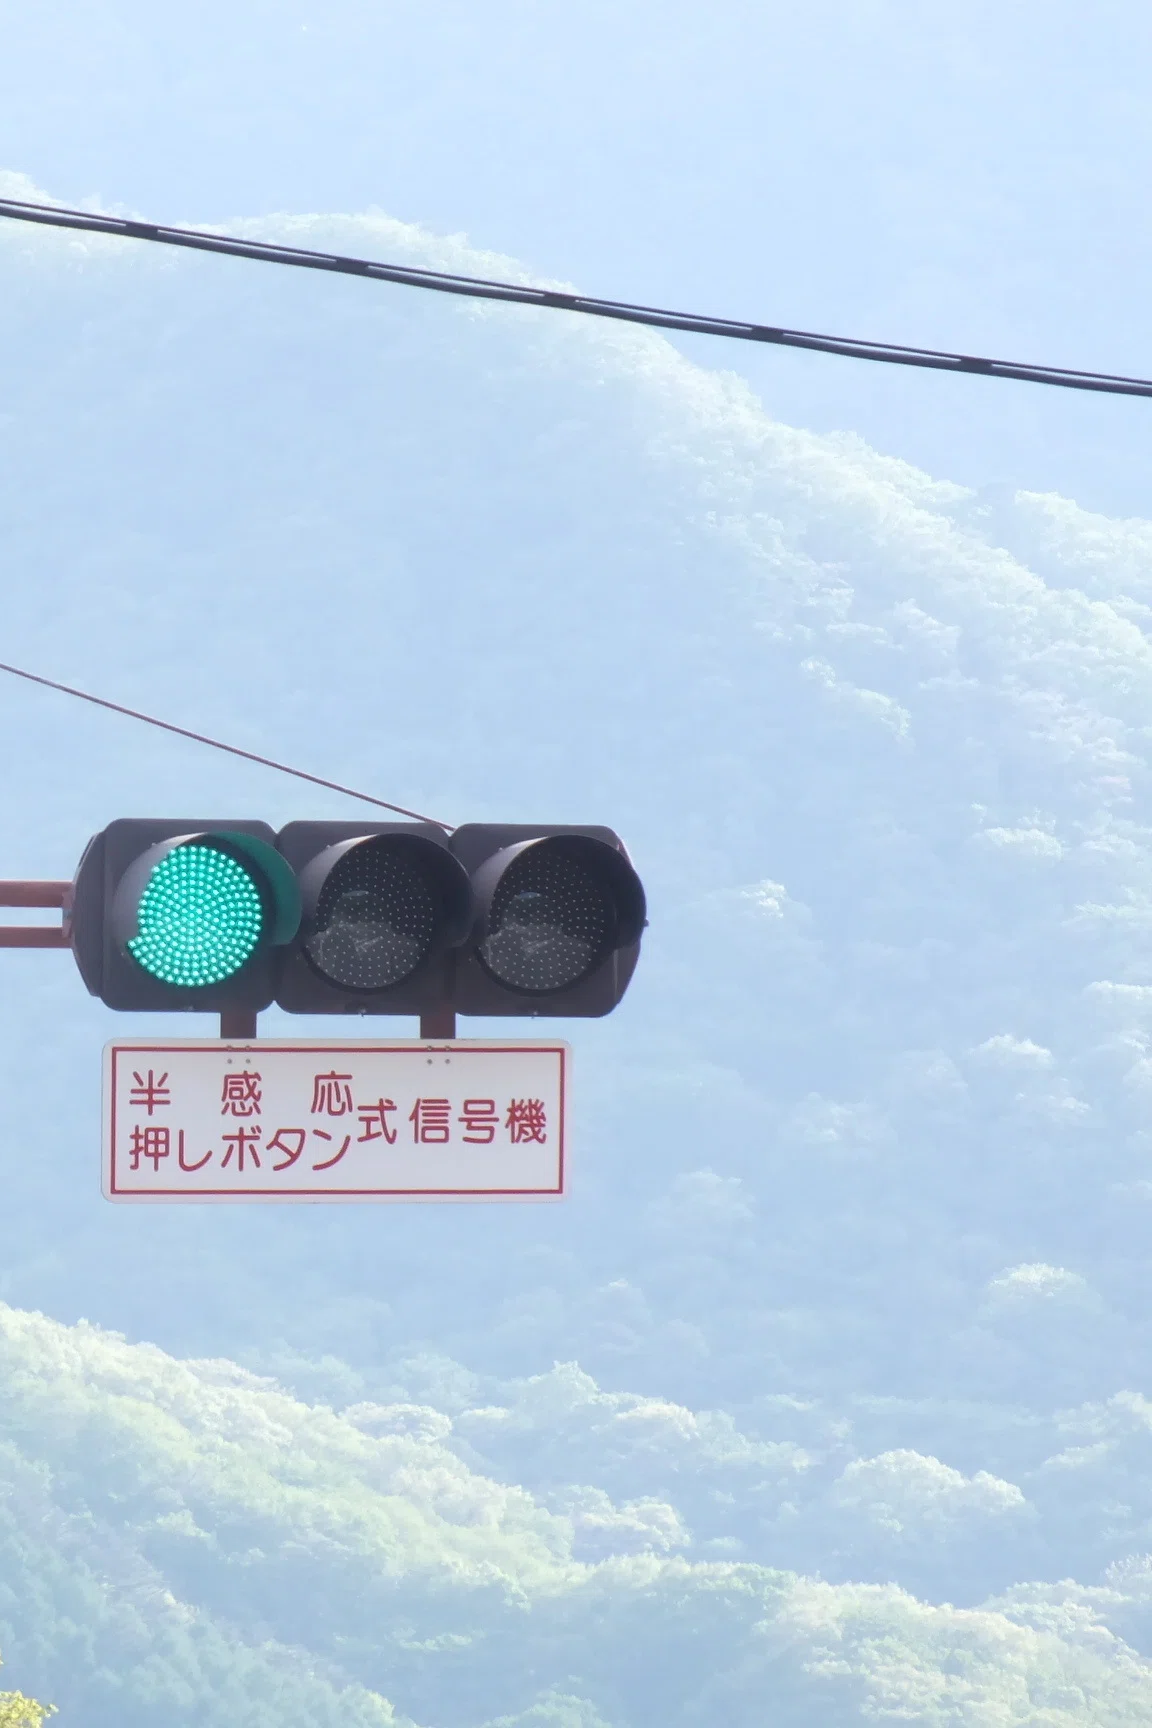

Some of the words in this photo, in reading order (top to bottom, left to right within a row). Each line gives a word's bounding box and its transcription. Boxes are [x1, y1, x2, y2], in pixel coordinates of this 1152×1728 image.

[129, 1069, 353, 1117] 半感応
[356, 1098, 547, 1145] 式信号機
[129, 1124, 351, 1172] 押しボタン
